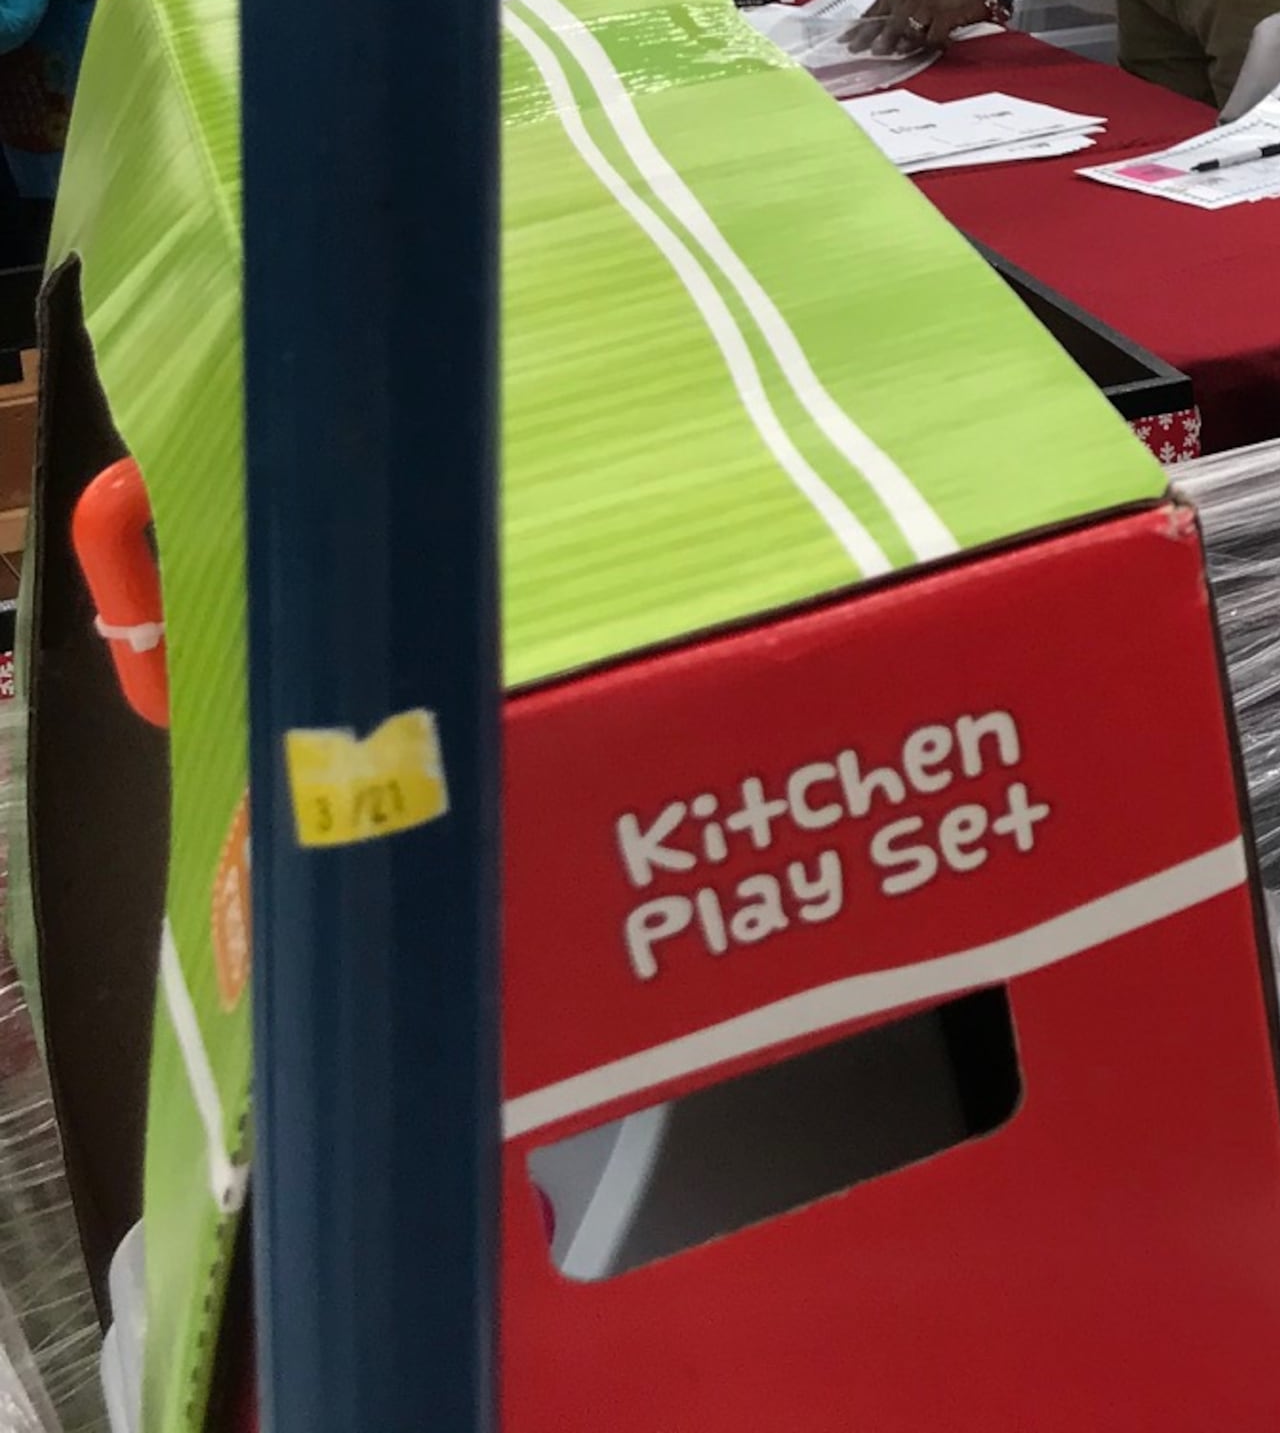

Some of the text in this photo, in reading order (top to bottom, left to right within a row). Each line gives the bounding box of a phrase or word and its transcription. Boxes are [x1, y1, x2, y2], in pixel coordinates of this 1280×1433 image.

[614, 709, 1022, 888] Kitchen
[624, 781, 1051, 982] Play Set
